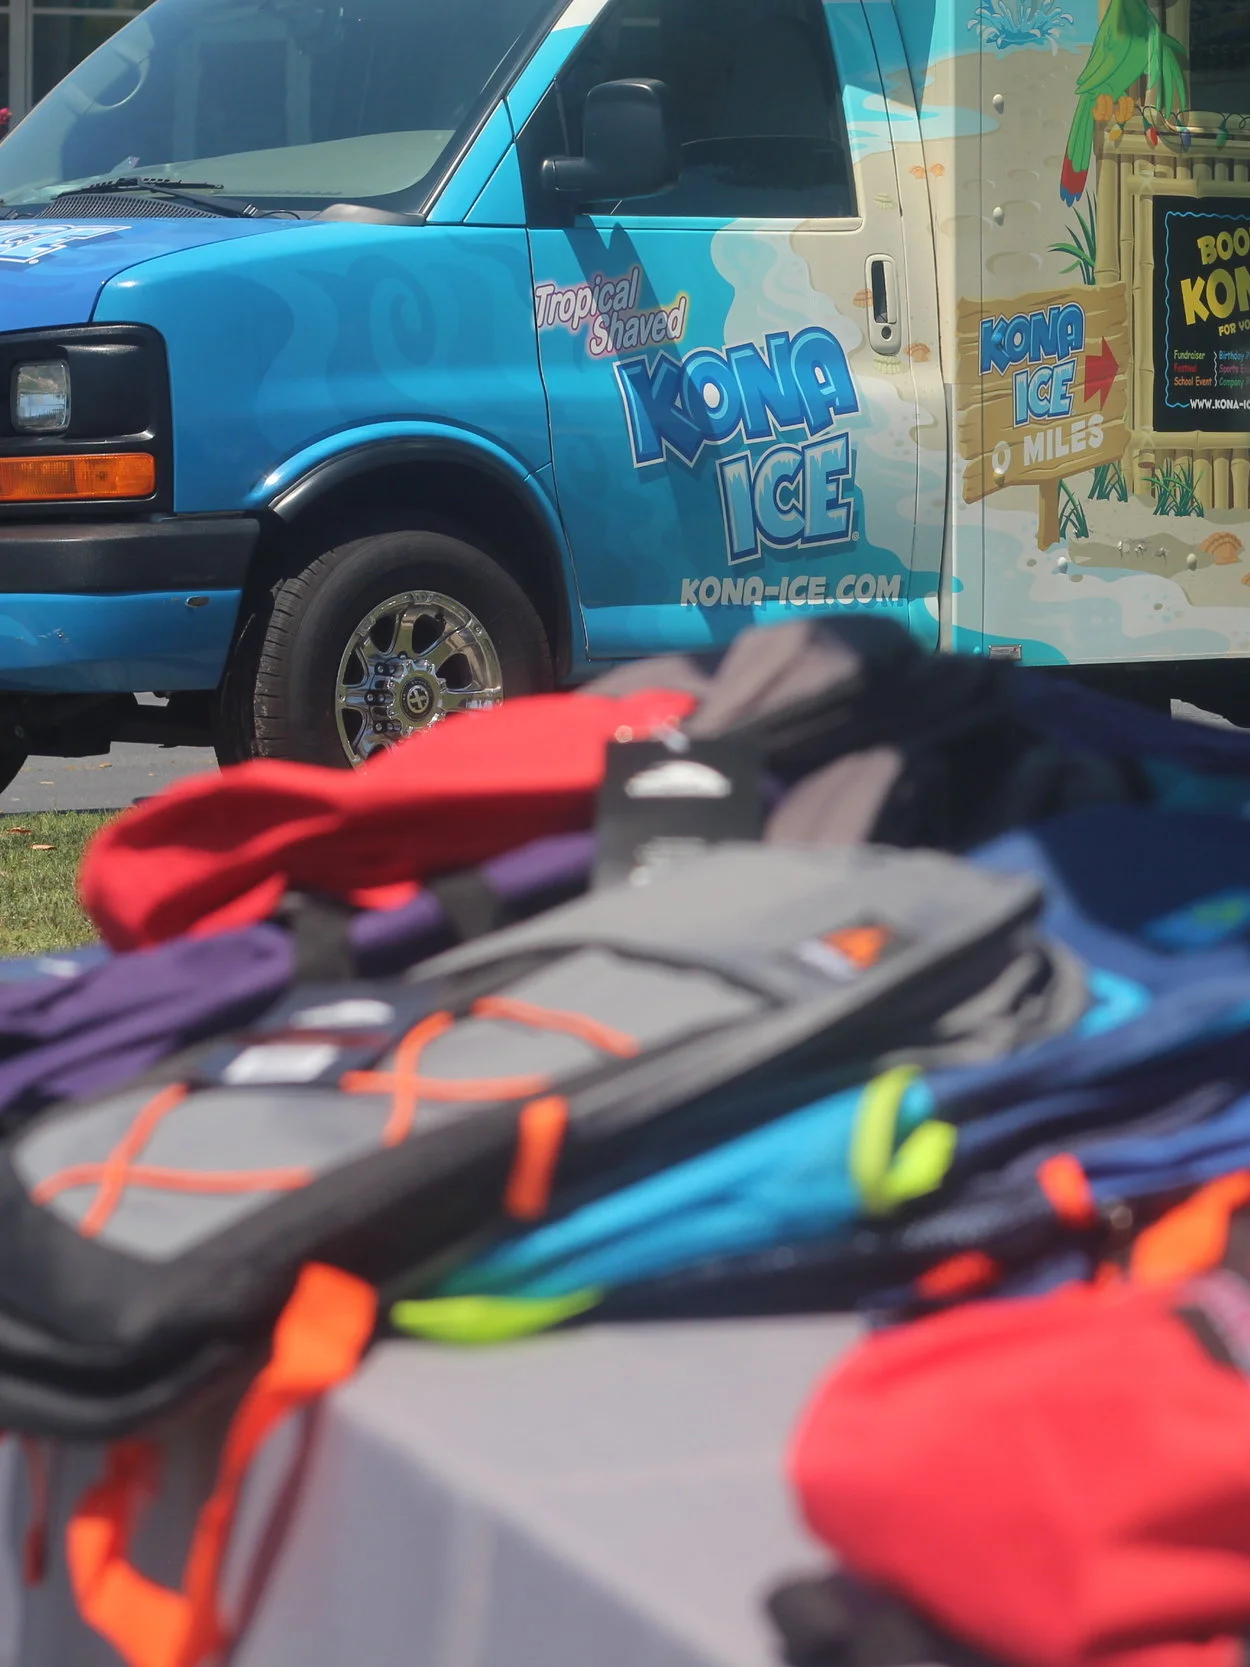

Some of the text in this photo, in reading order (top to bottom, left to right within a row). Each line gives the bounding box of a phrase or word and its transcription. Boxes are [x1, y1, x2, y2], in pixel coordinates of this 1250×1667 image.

[535, 267, 640, 330] Tropical
[590, 298, 687, 355] Shaved
[979, 302, 1086, 376] KONA
[1217, 322, 1237, 337] FOR
[1173, 350, 1206, 360] Fundraiser
[1173, 376, 1212, 386] School Event
[1218, 350, 1244, 362] Birthday
[613, 325, 861, 468] KONA
[1013, 360, 1077, 429] ICE
[1219, 377, 1244, 389] Company
[1023, 414, 1104, 467] MILES
[716, 432, 855, 566] ICE
[680, 573, 902, 608] KONA-ICE.COM
